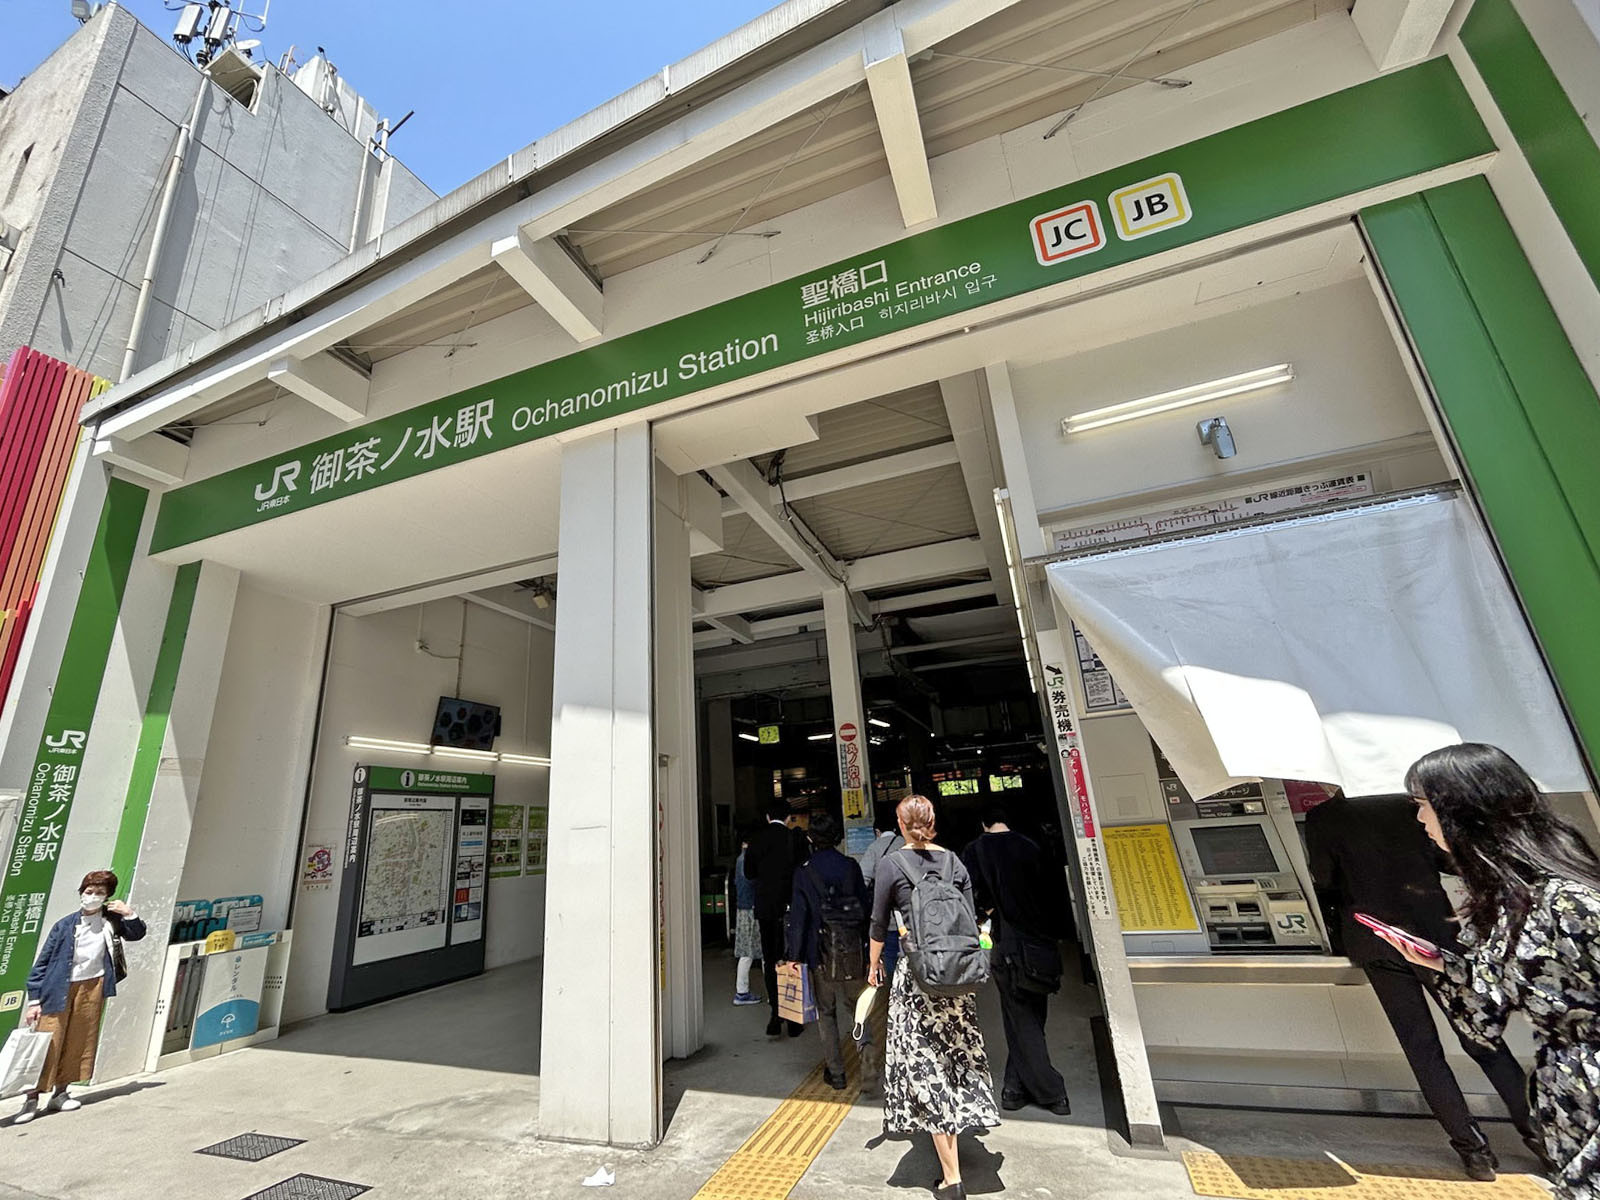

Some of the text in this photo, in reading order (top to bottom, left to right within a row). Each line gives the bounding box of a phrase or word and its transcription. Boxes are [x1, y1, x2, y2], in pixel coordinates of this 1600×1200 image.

[1131, 192, 1169, 222] JB
[1051, 218, 1086, 248] JC
[800, 259, 888, 309] 聖橋口
[804, 261, 982, 328] Hijiribashi Entrance
[878, 273, 998, 320] 히지리바시 입구
[805, 315, 865, 345] 圣桥入口
[511, 332, 779, 432] Ochanomizu Station
[309, 398, 495, 495] 御茶ノ水駅
[254, 460, 301, 500] JR
[256, 495, 291, 513] JR東日本
[1047, 676, 1064, 687] JR
[1051, 690, 1073, 733] 券売機
[45, 729, 87, 749] JR
[10, 762, 51, 876] Ochanomizu Station
[31, 763, 77, 862] 御茶ノ水駅
[21, 892, 46, 935] 聖橋口
[1277, 914, 1308, 929] JR
[4, 996, 17, 1006] JB
